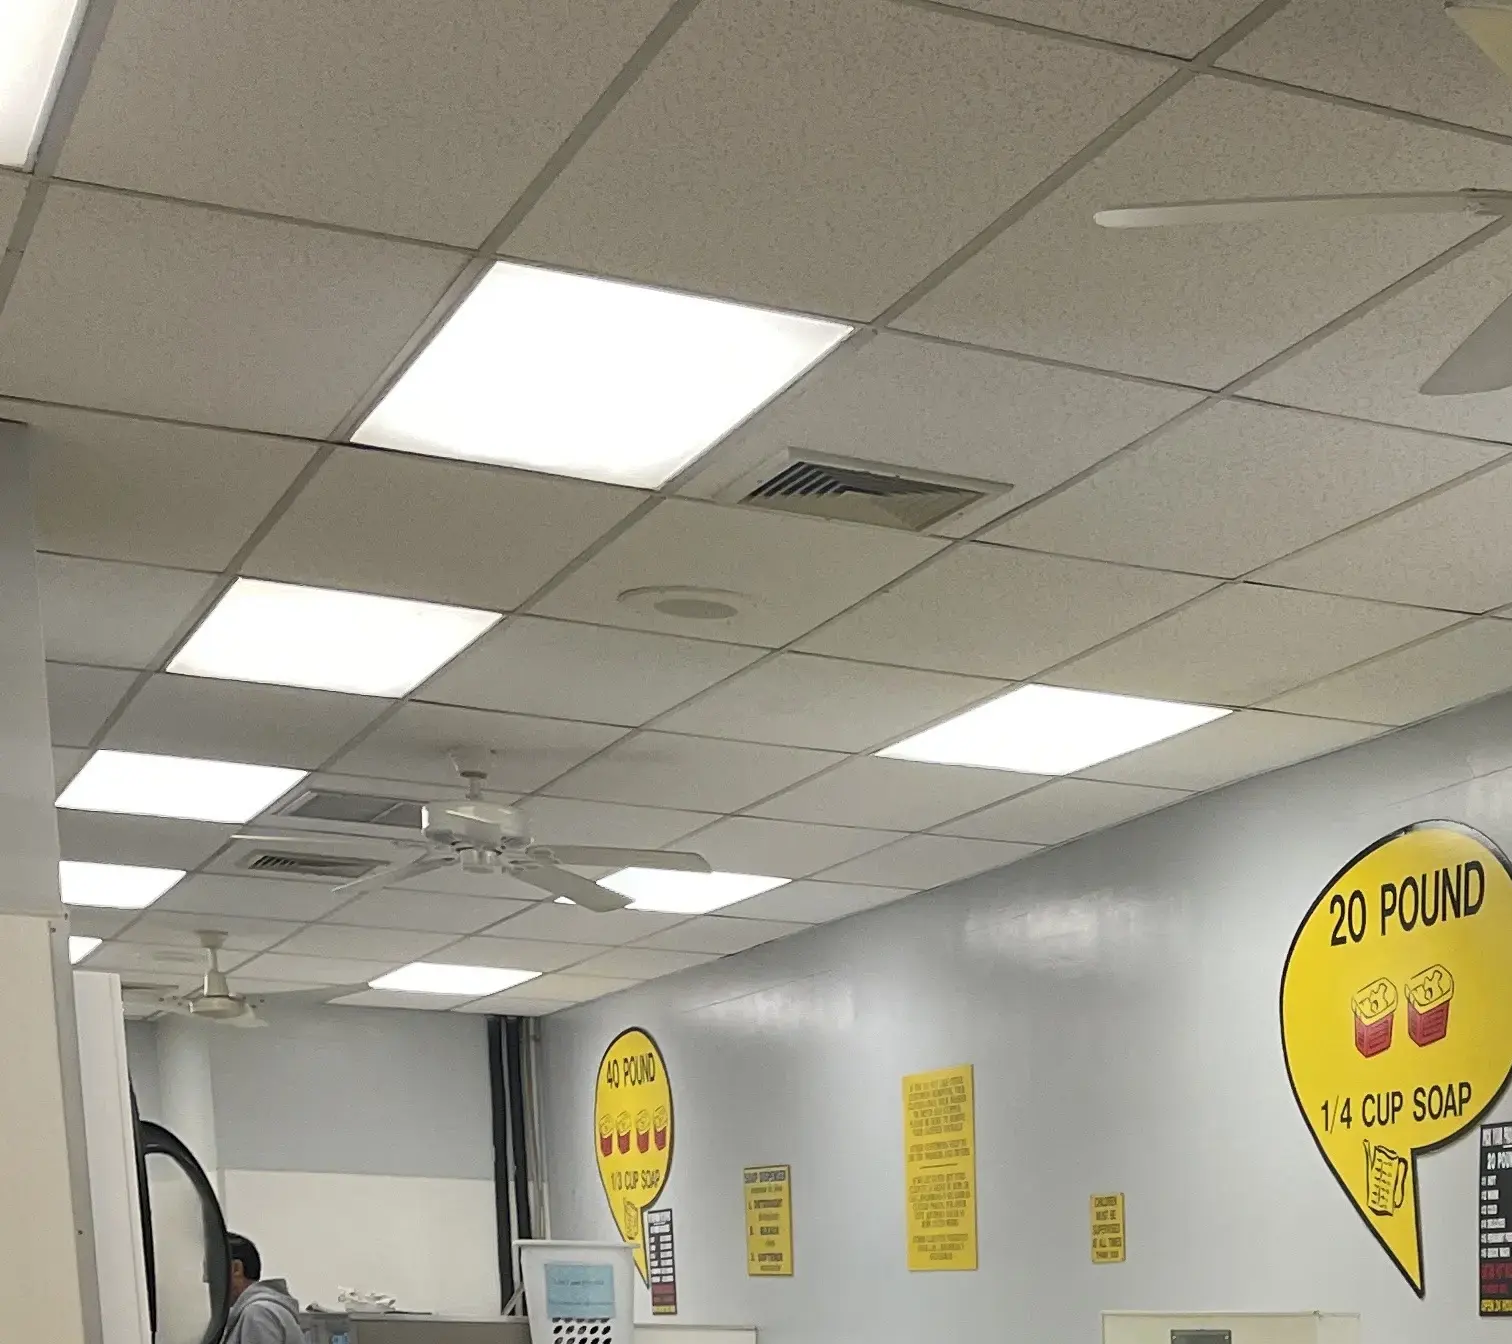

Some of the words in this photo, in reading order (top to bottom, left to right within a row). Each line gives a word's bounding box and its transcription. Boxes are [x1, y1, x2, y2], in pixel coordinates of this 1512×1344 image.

[1329, 889, 1366, 946] 20
[1380, 860, 1485, 936] POUND
[606, 1058, 620, 1089] 40
[623, 1052, 656, 1087] POUND
[1321, 1095, 1352, 1134] 1/4
[1362, 1091, 1403, 1127] CUP
[1413, 1081, 1472, 1123] SOAP
[624, 1170, 639, 1191] CUP
[641, 1169, 660, 1190] SOAP
